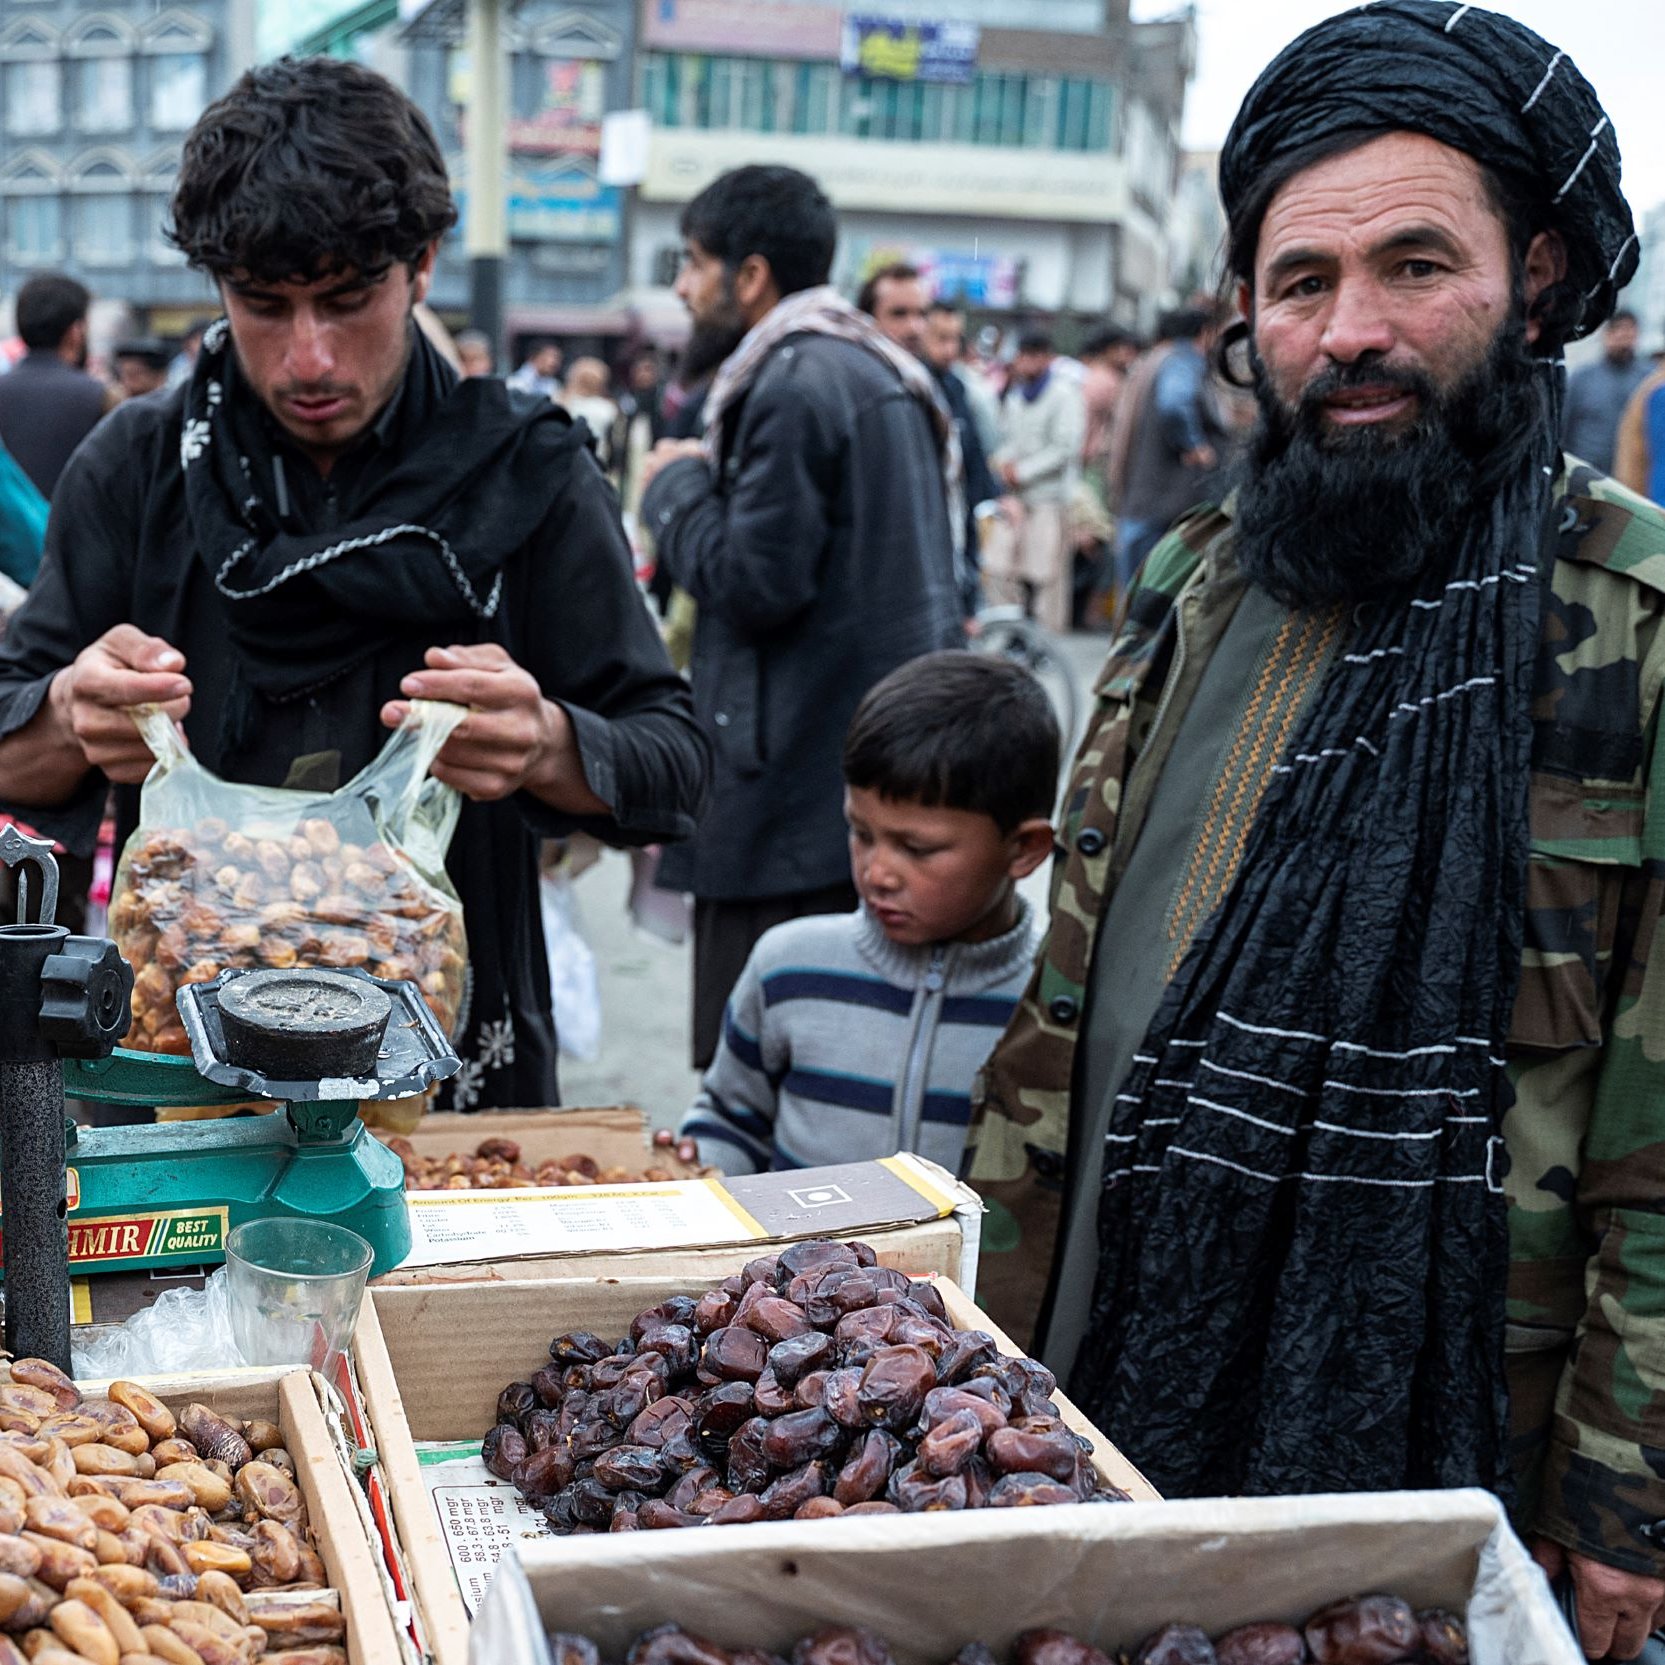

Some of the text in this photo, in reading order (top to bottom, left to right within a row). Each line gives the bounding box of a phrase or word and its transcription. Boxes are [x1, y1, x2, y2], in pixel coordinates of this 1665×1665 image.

[176, 1220, 208, 1233] BEST
[167, 1233, 218, 1250] QUALITY
[428, 1236, 476, 1244] Potassium
[445, 1496, 459, 1517] mgr
[460, 1498, 473, 1516] mgr
[476, 1497, 489, 1516] mgr
[489, 1496, 504, 1514] mgr
[513, 1496, 528, 1515] mgr
[449, 1519, 465, 1537] 650
[464, 1517, 479, 1536] 67.8
[480, 1517, 495, 1537] 63.8
[496, 1524, 511, 1535] 51
[534, 1518, 551, 1536] 0.21
[457, 1545, 472, 1563] 600
[472, 1543, 487, 1563] 58.3
